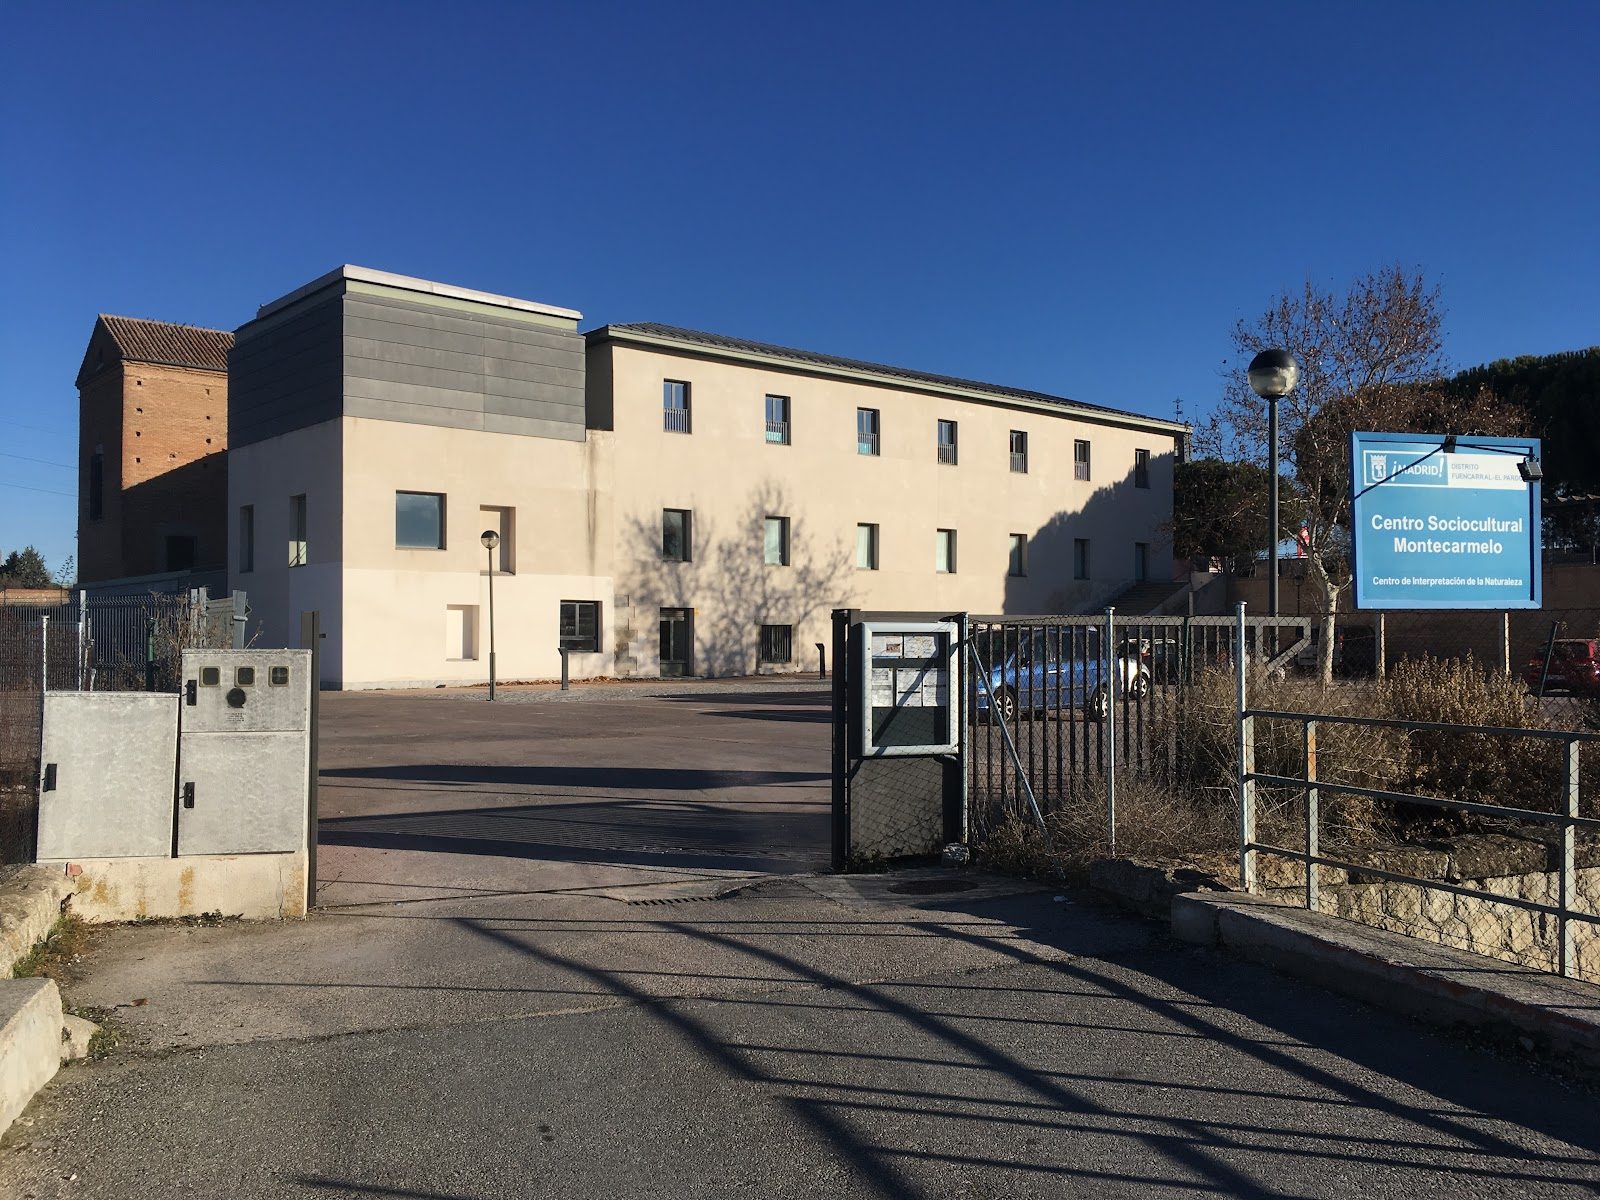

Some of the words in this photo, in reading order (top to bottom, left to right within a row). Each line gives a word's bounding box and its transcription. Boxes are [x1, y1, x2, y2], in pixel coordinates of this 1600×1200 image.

[1451, 463, 1480, 471] DISTRITO
[1371, 514, 1424, 530] Centro
[1428, 515, 1523, 532] Sociocultural
[1394, 537, 1503, 554] Montecarmelo
[1372, 576, 1400, 586] Centro
[1401, 576, 1412, 585] de
[1412, 576, 1465, 587] Interpretación
[1466, 577, 1477, 586] de
[1477, 577, 1484, 586] la
[1484, 577, 1523, 586] Naturaleza
